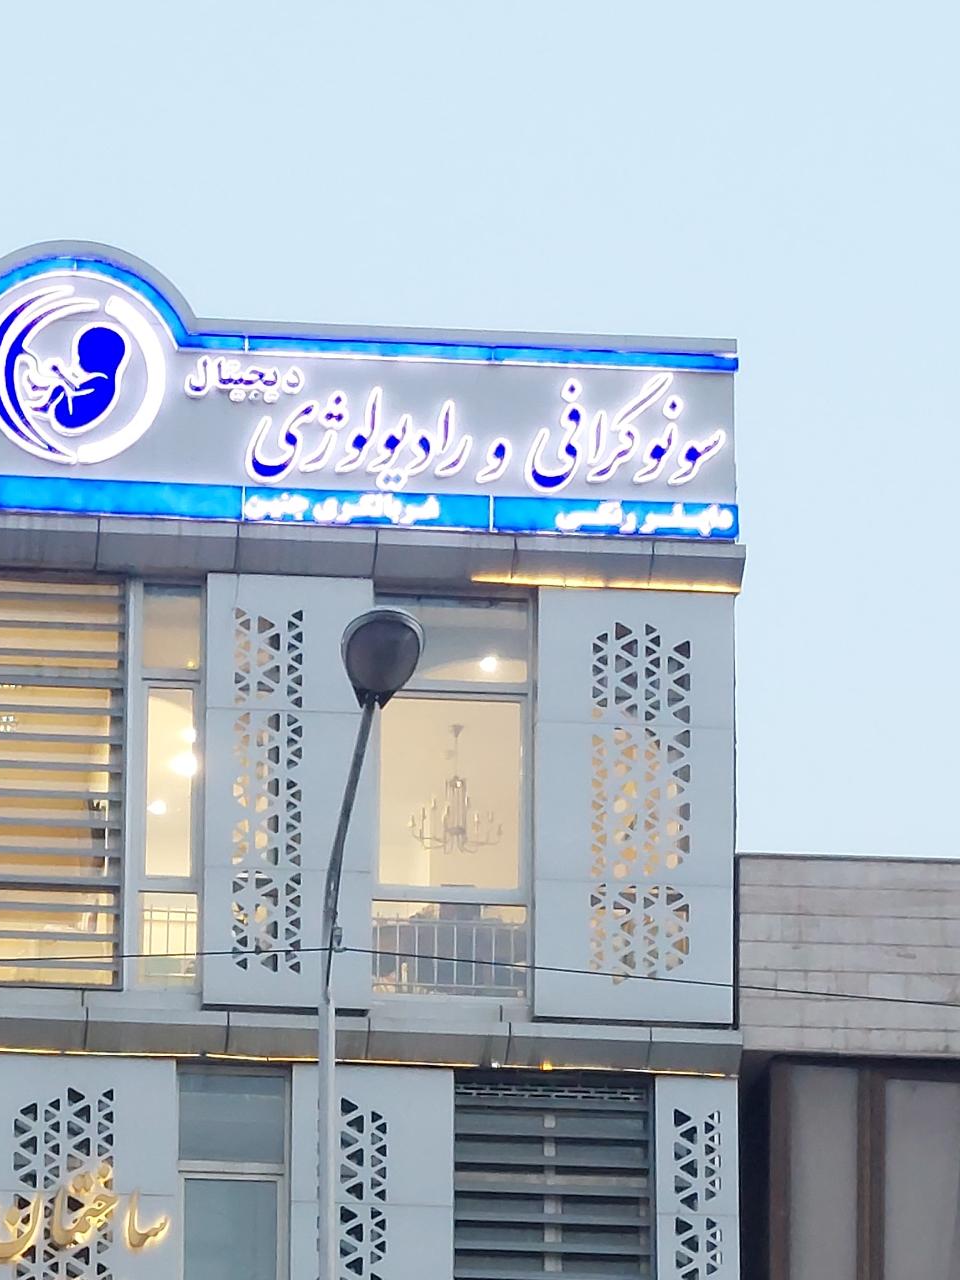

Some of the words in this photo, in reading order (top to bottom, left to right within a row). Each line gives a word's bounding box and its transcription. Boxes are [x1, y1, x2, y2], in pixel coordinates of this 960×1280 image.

[185, 355, 305, 401] دیجیتال
[244, 387, 474, 490] رادیولوژی
[476, 437, 512, 482] و
[524, 372, 726, 493] سونوگرافی
